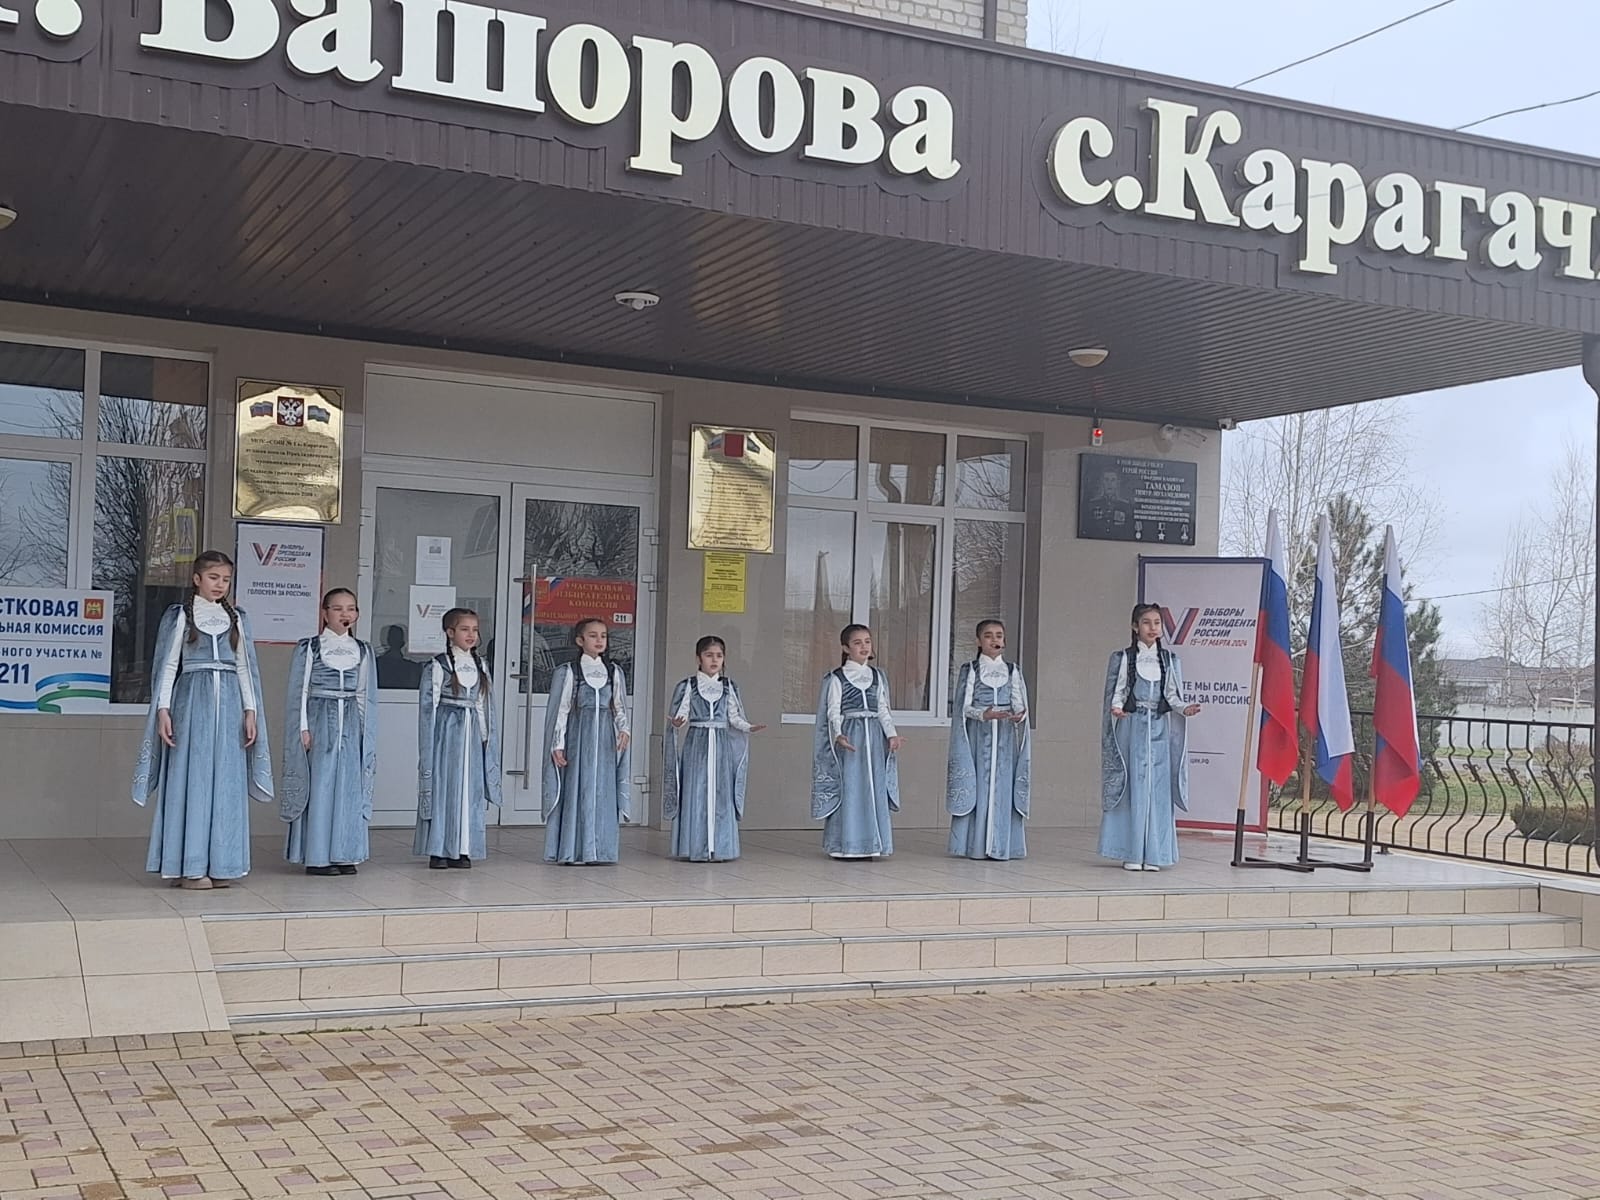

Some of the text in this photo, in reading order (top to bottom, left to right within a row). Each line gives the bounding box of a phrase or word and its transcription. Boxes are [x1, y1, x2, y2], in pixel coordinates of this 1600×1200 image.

[1053, 98, 1600, 280] с.Карагач
[566, 582, 623, 592] УЧАСТКОВАЯ
[568, 600, 618, 609] КОМИССИЯ
[1203, 608, 1245, 616] ВЫБОРЫ
[615, 614, 627, 622] 211
[1198, 618, 1257, 628] ПРЕЗИДЕНТА
[35, 623, 104, 636] КОМИССИЯ
[1194, 628, 1231, 637] РОССИИ
[1208, 639, 1231, 647] МАРТА
[1231, 639, 1248, 647] 2024
[0, 647, 103, 659] НОГО УЧАСТКА №
[0, 663, 29, 684] 211
[1194, 682, 1211, 691] МЫ
[1213, 682, 1239, 692] СИЛА
[1198, 694, 1210, 704] ЗА
